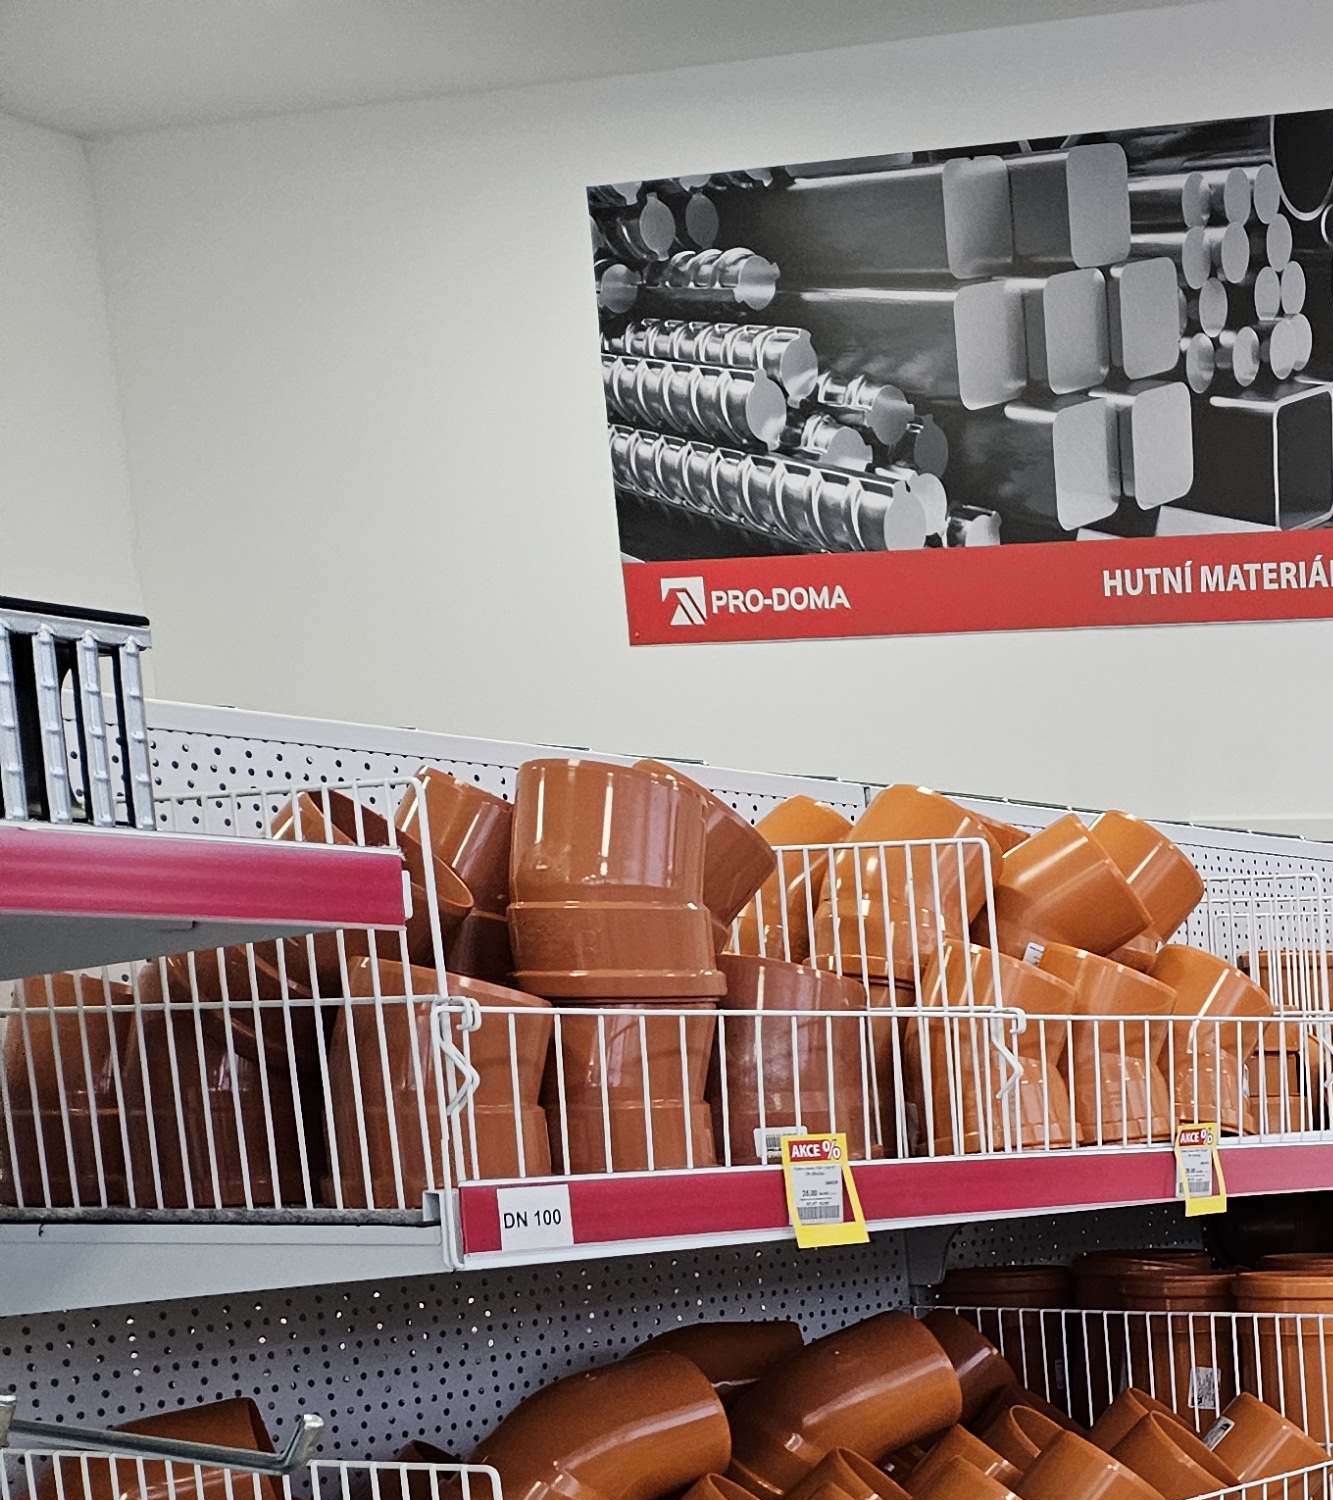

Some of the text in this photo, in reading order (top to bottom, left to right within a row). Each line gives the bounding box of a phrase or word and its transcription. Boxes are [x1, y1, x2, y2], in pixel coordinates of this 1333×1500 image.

[1103, 561, 1193, 597] HUTNÍ
[711, 585, 851, 614] PRO-DOMA
[1180, 1127, 1213, 1145] AKCE %
[791, 1138, 841, 1160] AKCE %
[503, 1208, 561, 1229] DN 100
